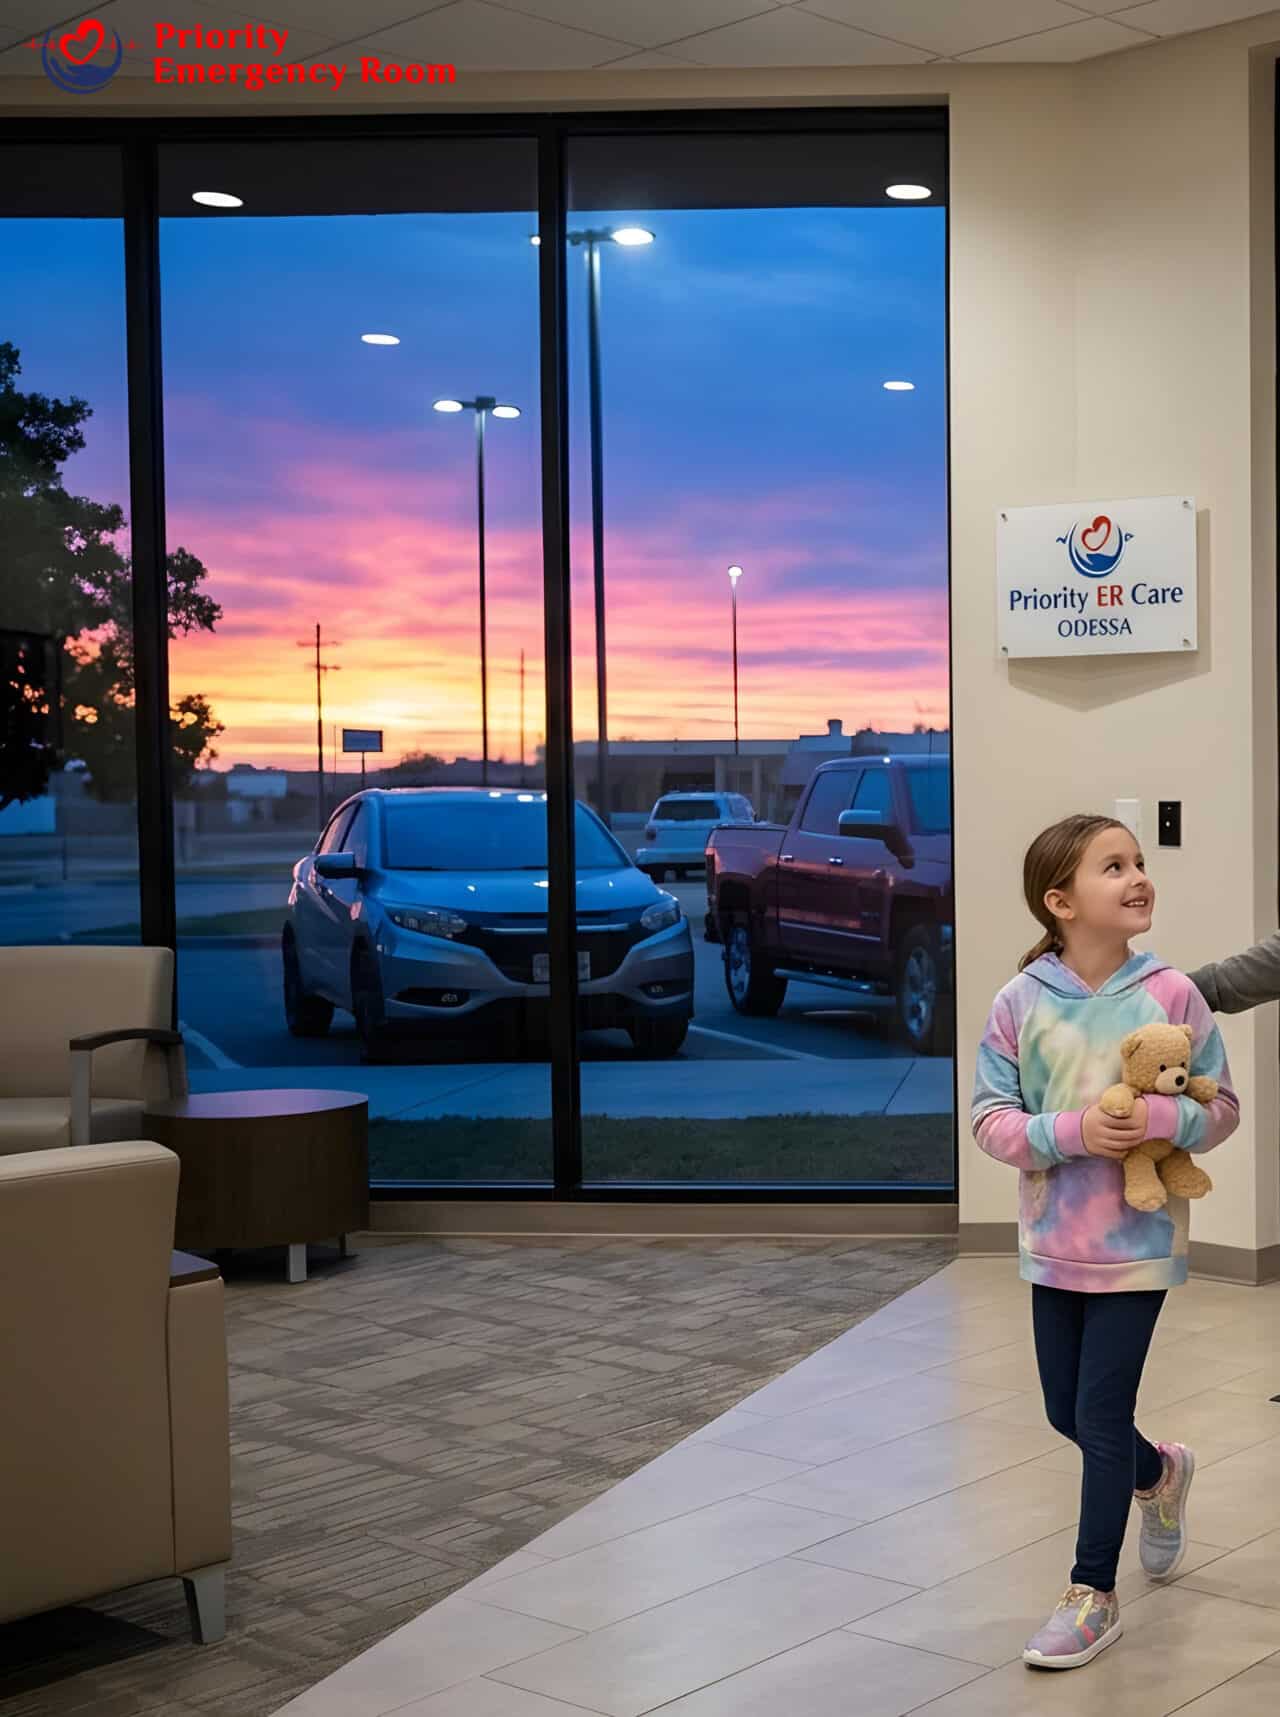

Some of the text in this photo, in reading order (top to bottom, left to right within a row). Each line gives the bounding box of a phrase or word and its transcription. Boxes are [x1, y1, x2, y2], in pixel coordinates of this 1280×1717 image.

[1009, 583, 1184, 614] Priority ER Care
[1057, 618, 1133, 638] ODESSA
